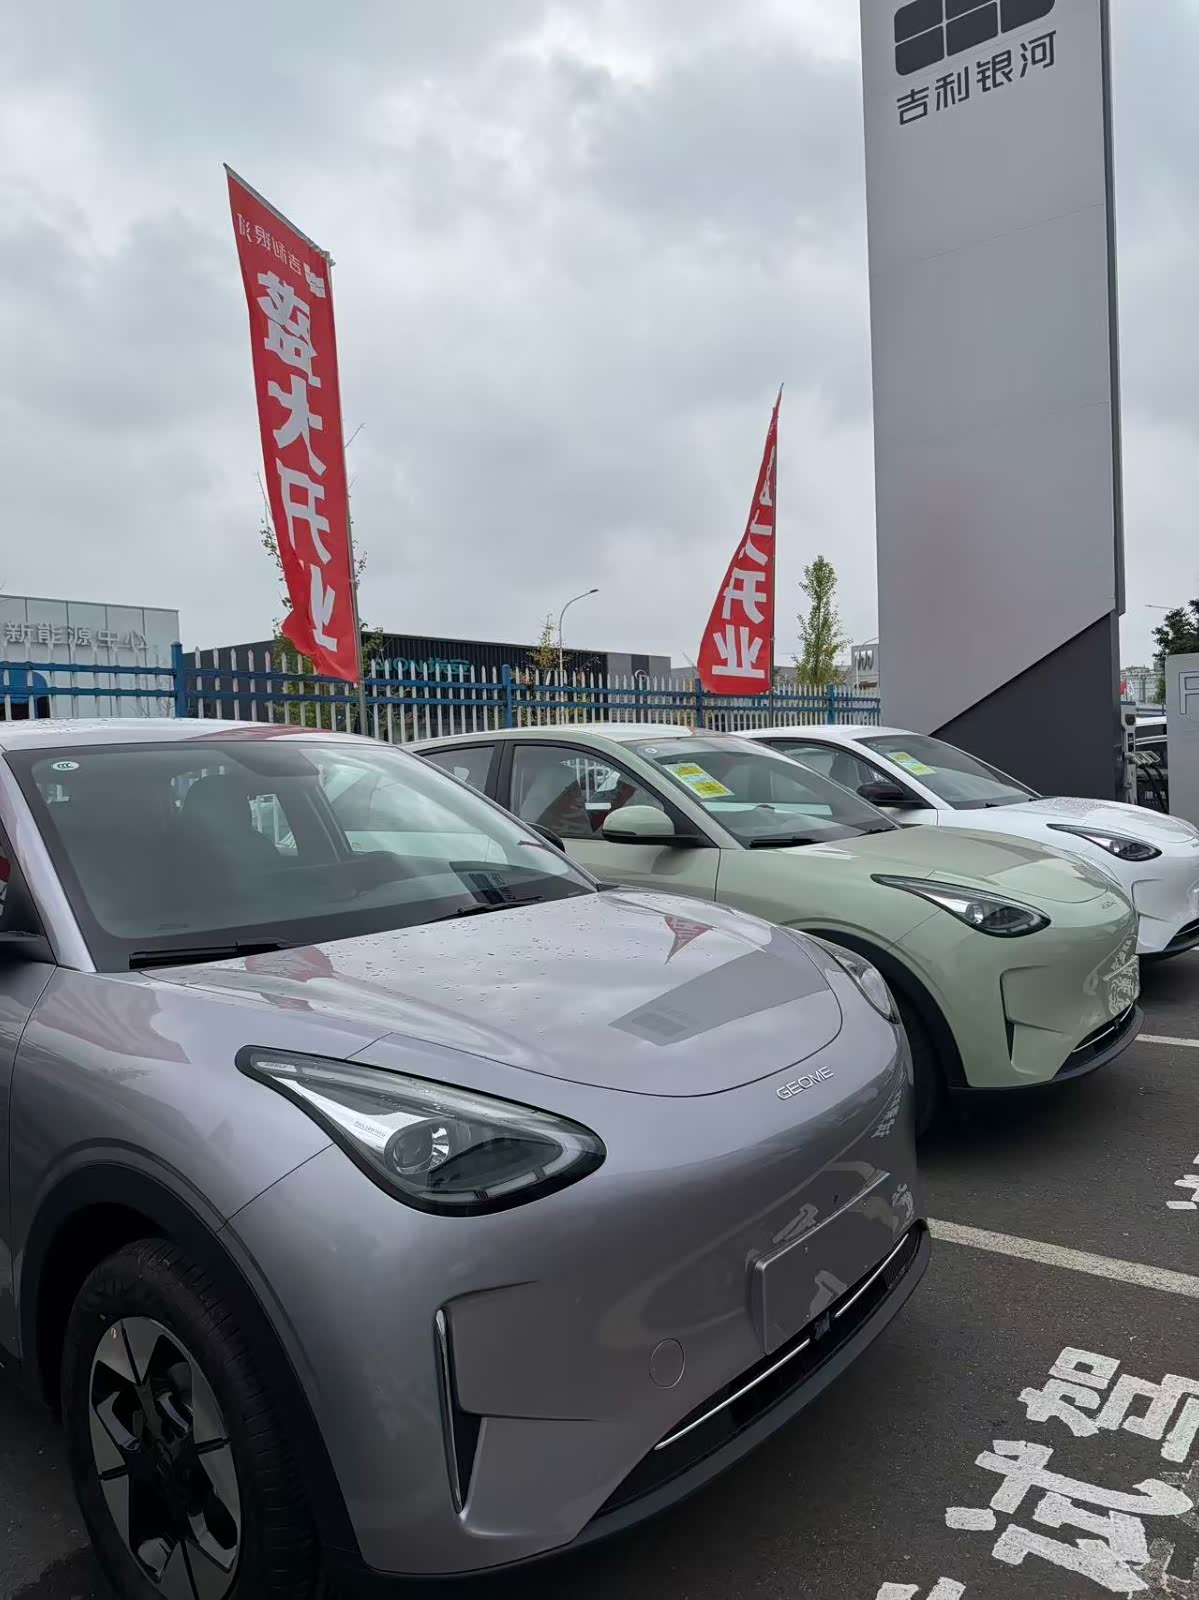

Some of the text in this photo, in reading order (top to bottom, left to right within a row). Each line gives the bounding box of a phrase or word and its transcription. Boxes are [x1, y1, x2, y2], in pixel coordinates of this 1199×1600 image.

[896, 29, 1057, 126] 吉利银河
[5, 621, 148, 650] 新能源中心
[775, 1065, 834, 1101] GEOME
